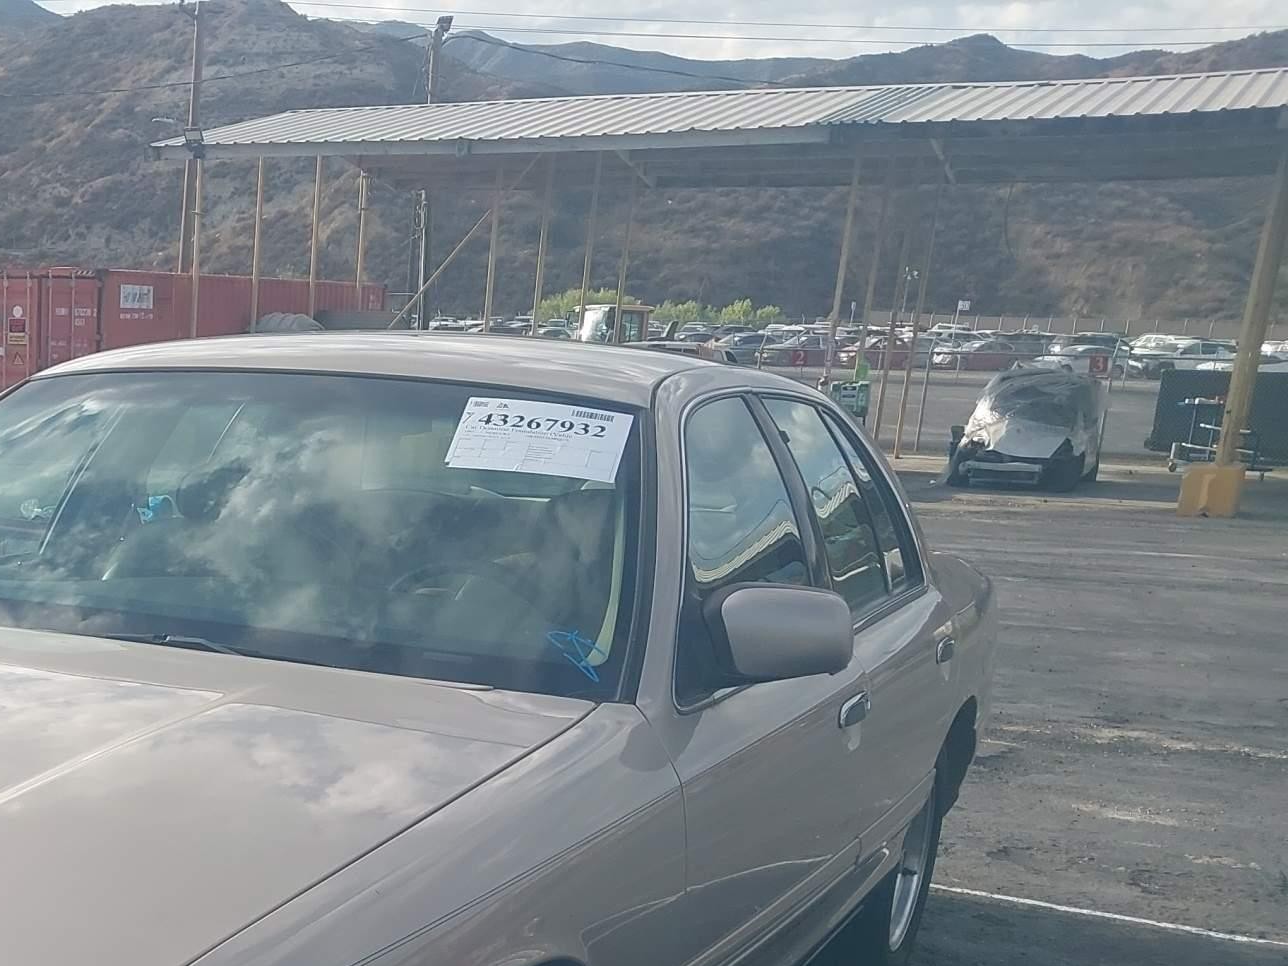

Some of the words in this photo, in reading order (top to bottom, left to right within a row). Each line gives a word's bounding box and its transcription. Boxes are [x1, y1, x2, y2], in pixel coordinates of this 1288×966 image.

[795, 351, 804, 364] 2
[1095, 354, 1108, 370] 3
[478, 412, 607, 438] 43267932
